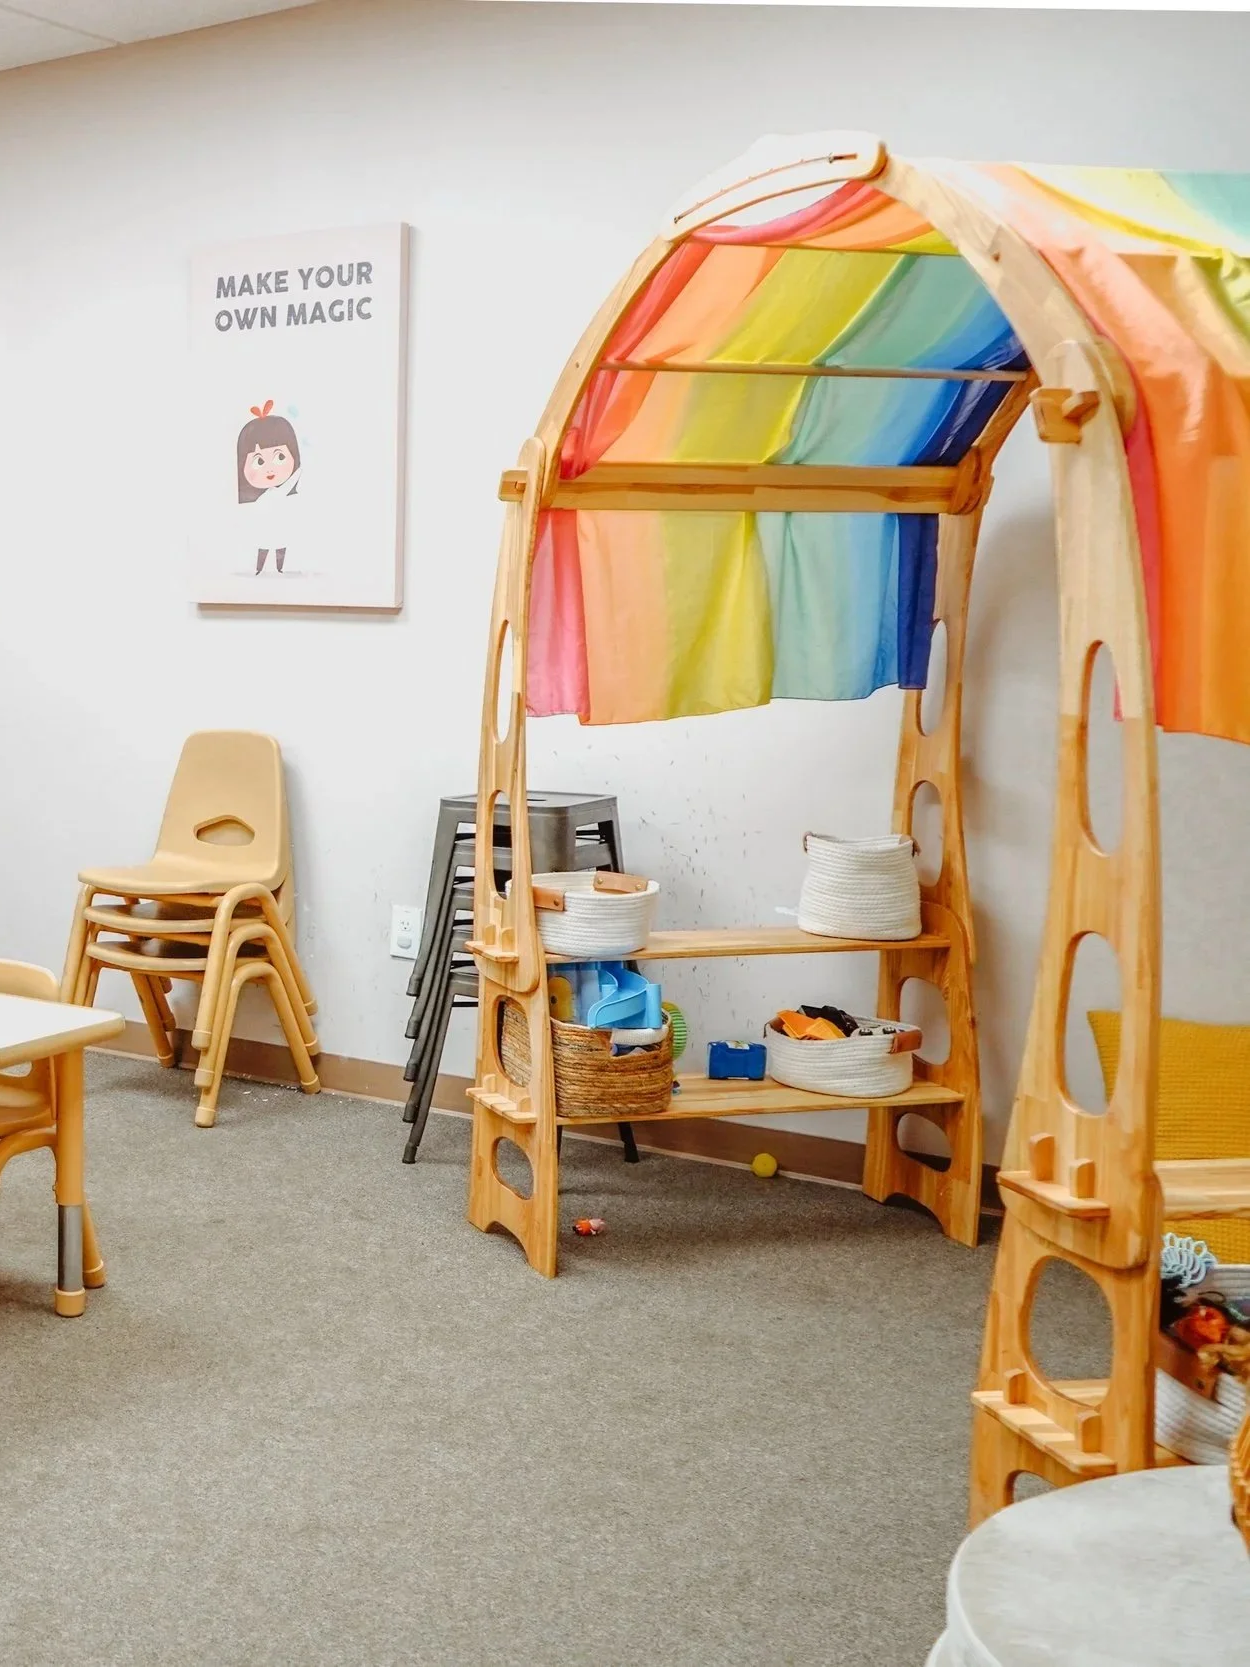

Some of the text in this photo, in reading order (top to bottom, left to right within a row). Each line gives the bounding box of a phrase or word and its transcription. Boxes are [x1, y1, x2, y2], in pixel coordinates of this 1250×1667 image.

[216, 261, 373, 299] MAKE YOUR
[215, 296, 373, 332] OWN MAGIC
